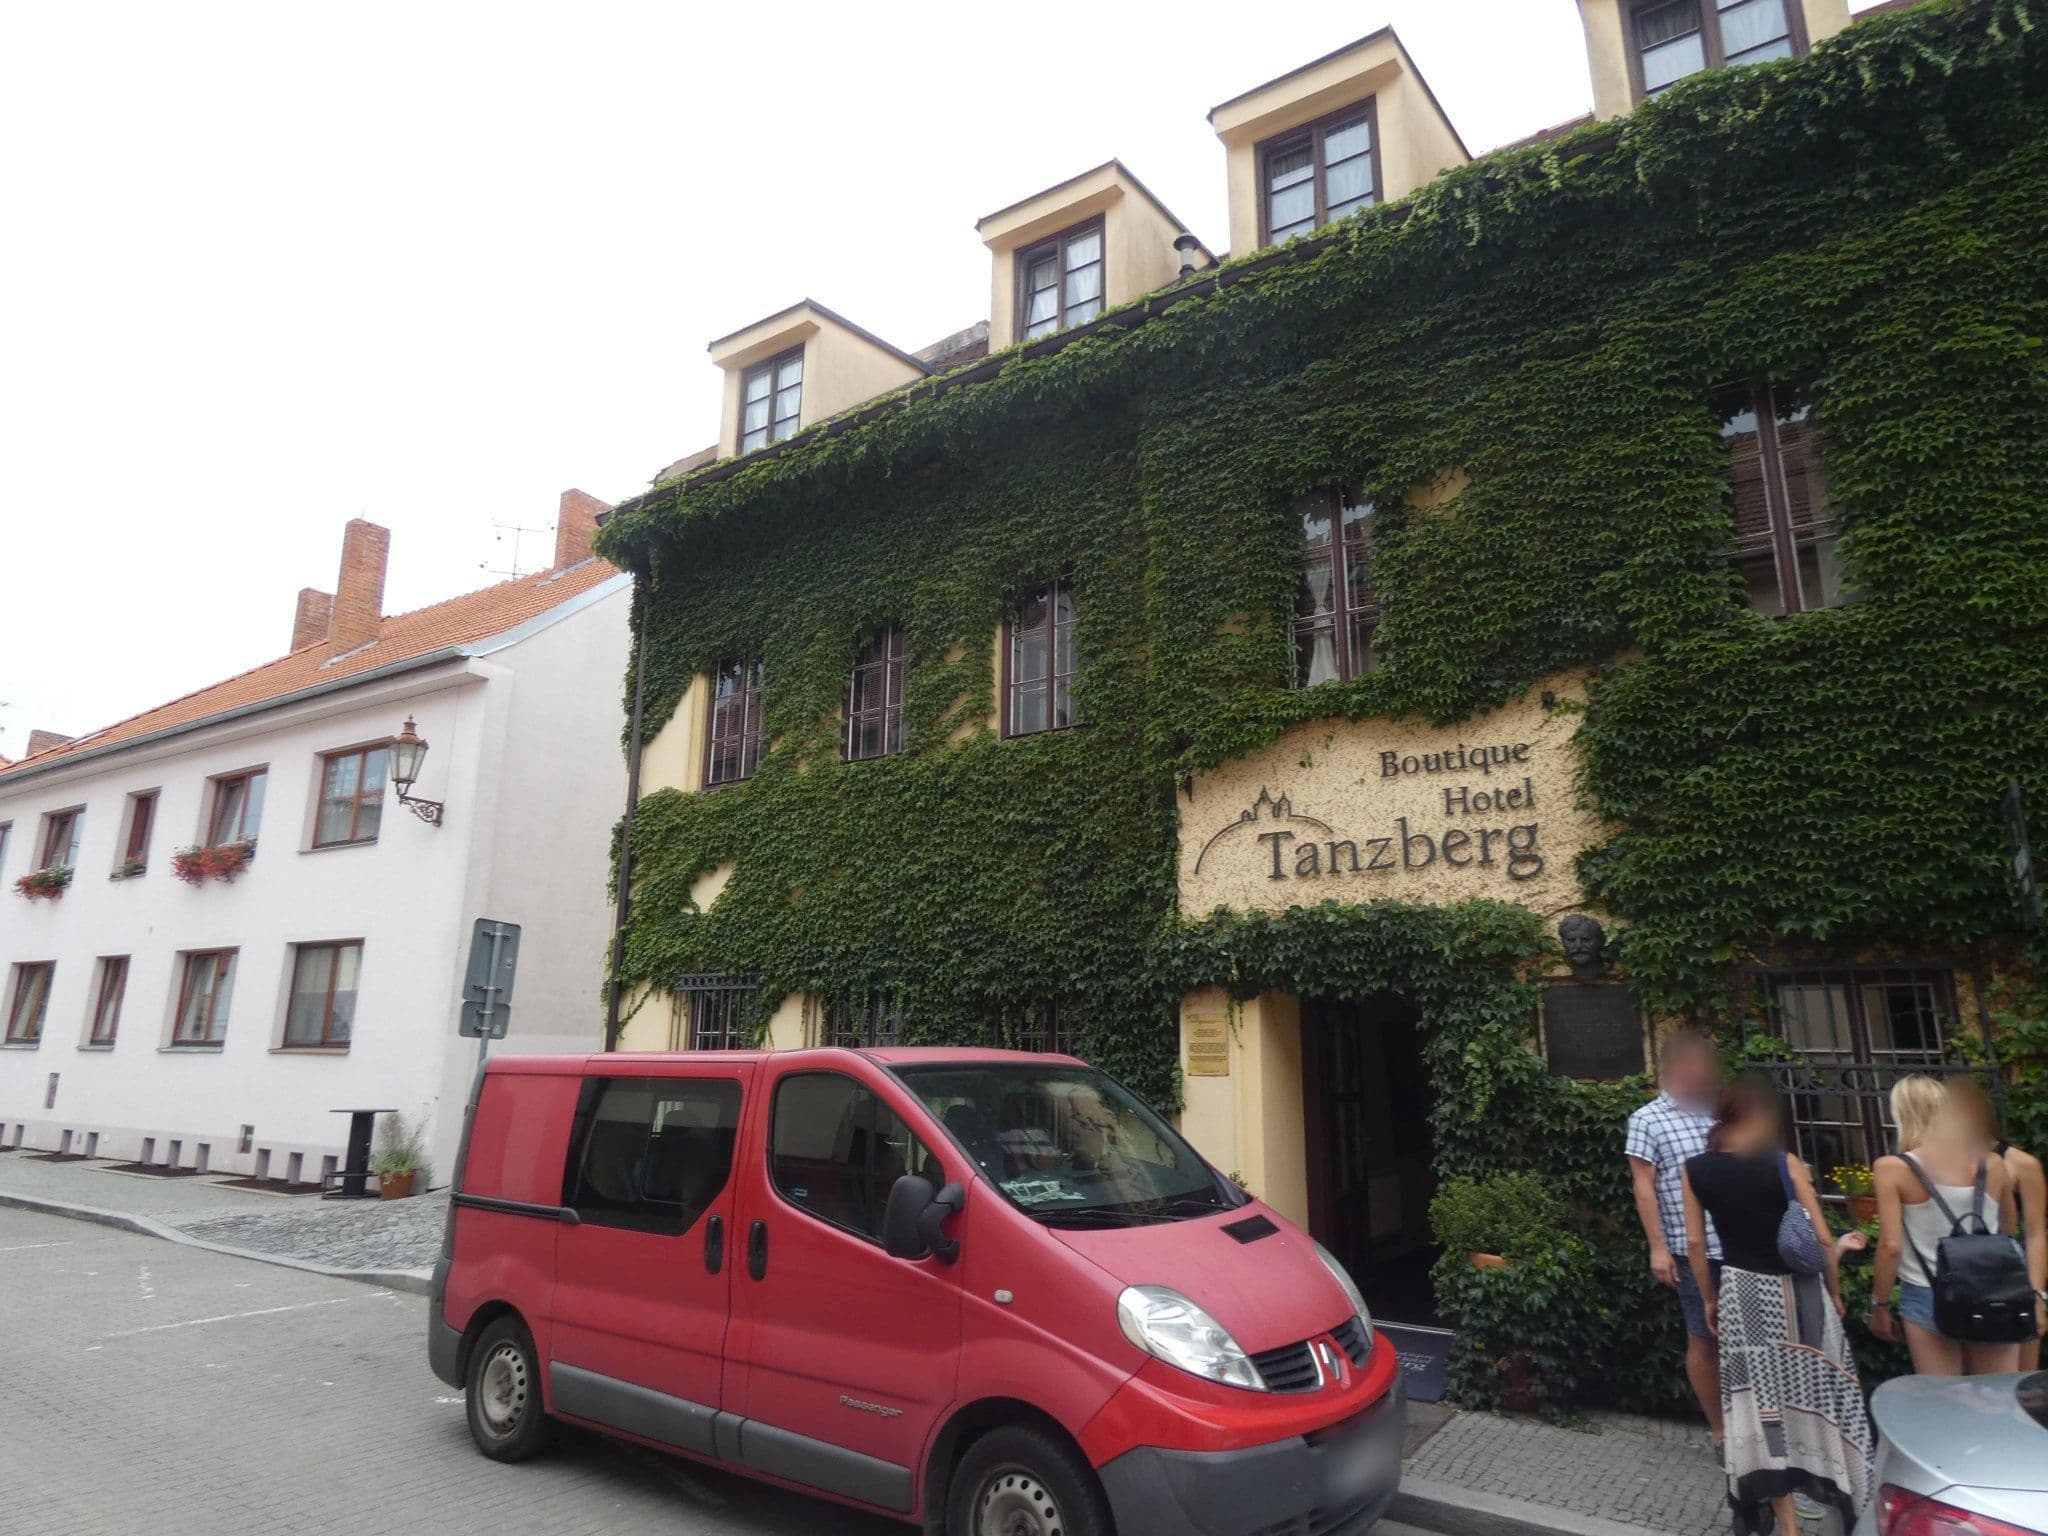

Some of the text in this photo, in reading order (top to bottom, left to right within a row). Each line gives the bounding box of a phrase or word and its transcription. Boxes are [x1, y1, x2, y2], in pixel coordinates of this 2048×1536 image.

[1378, 743, 1531, 778] Boutique
[1442, 777, 1535, 815] Hotel
[1257, 816, 1545, 880] Tanzberg
[839, 1395, 903, 1417] Passenger
